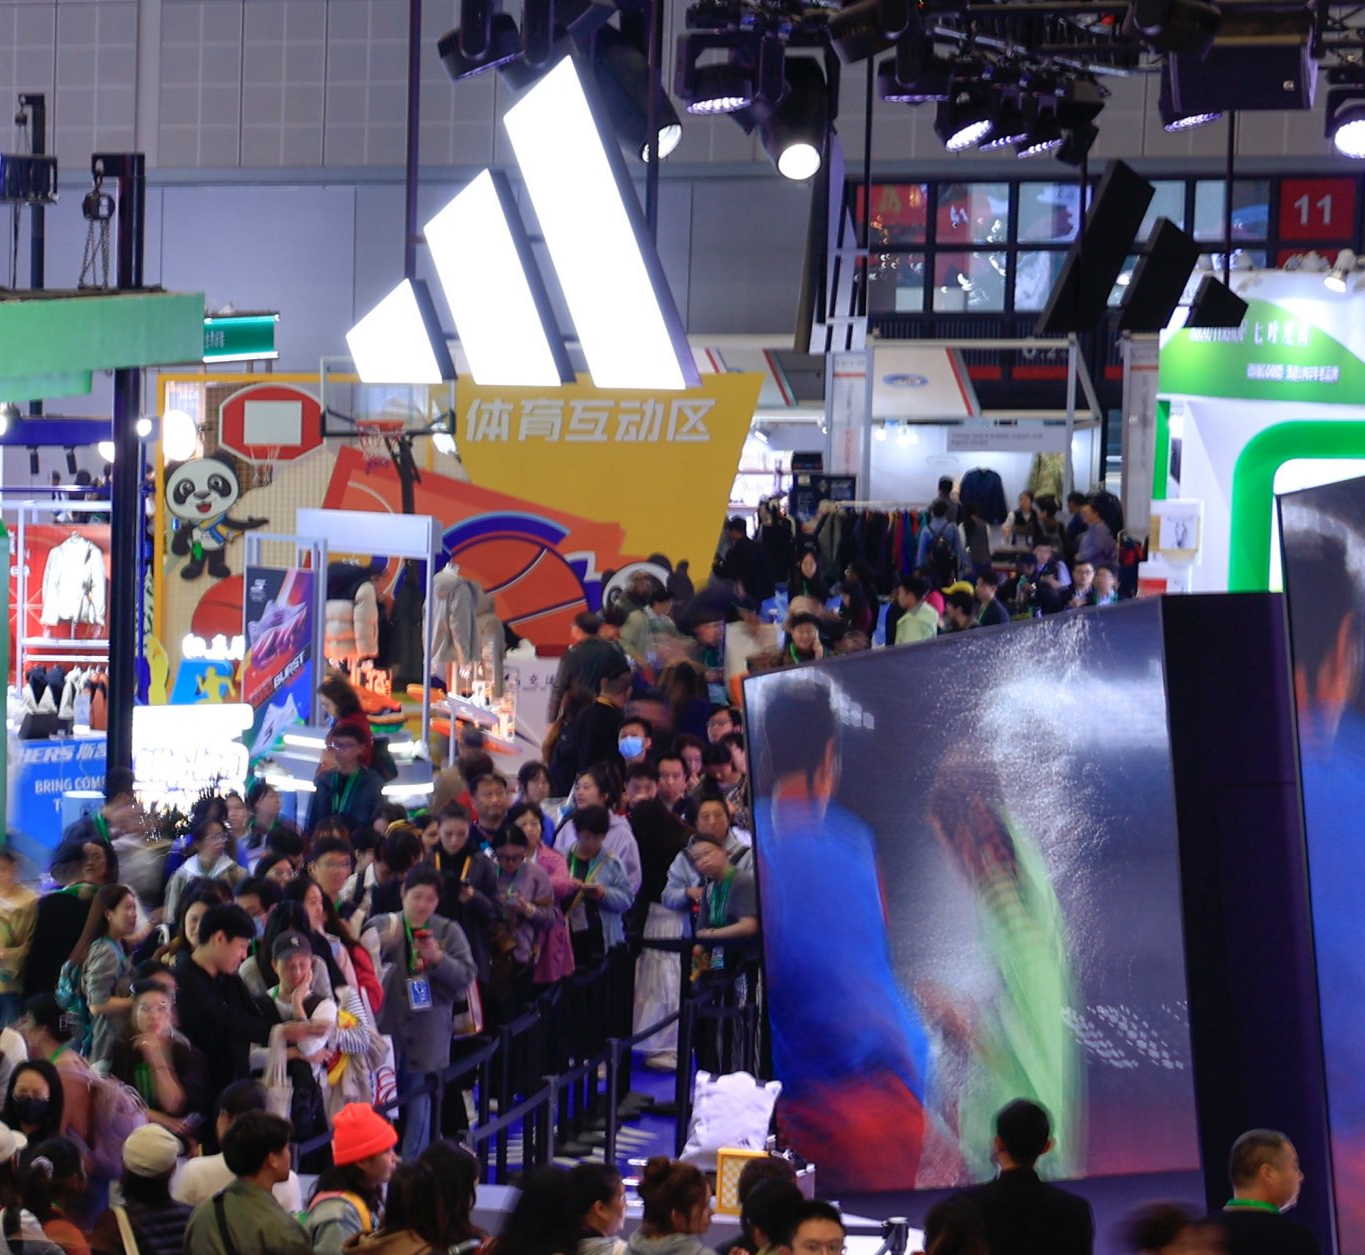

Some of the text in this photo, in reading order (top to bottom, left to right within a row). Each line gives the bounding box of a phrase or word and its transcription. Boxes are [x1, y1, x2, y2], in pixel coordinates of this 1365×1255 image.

[1294, 193, 1332, 226] 11
[466, 397, 716, 442] 体育互动区
[272, 651, 306, 689] BURST
[34, 777, 72, 795] BRING
